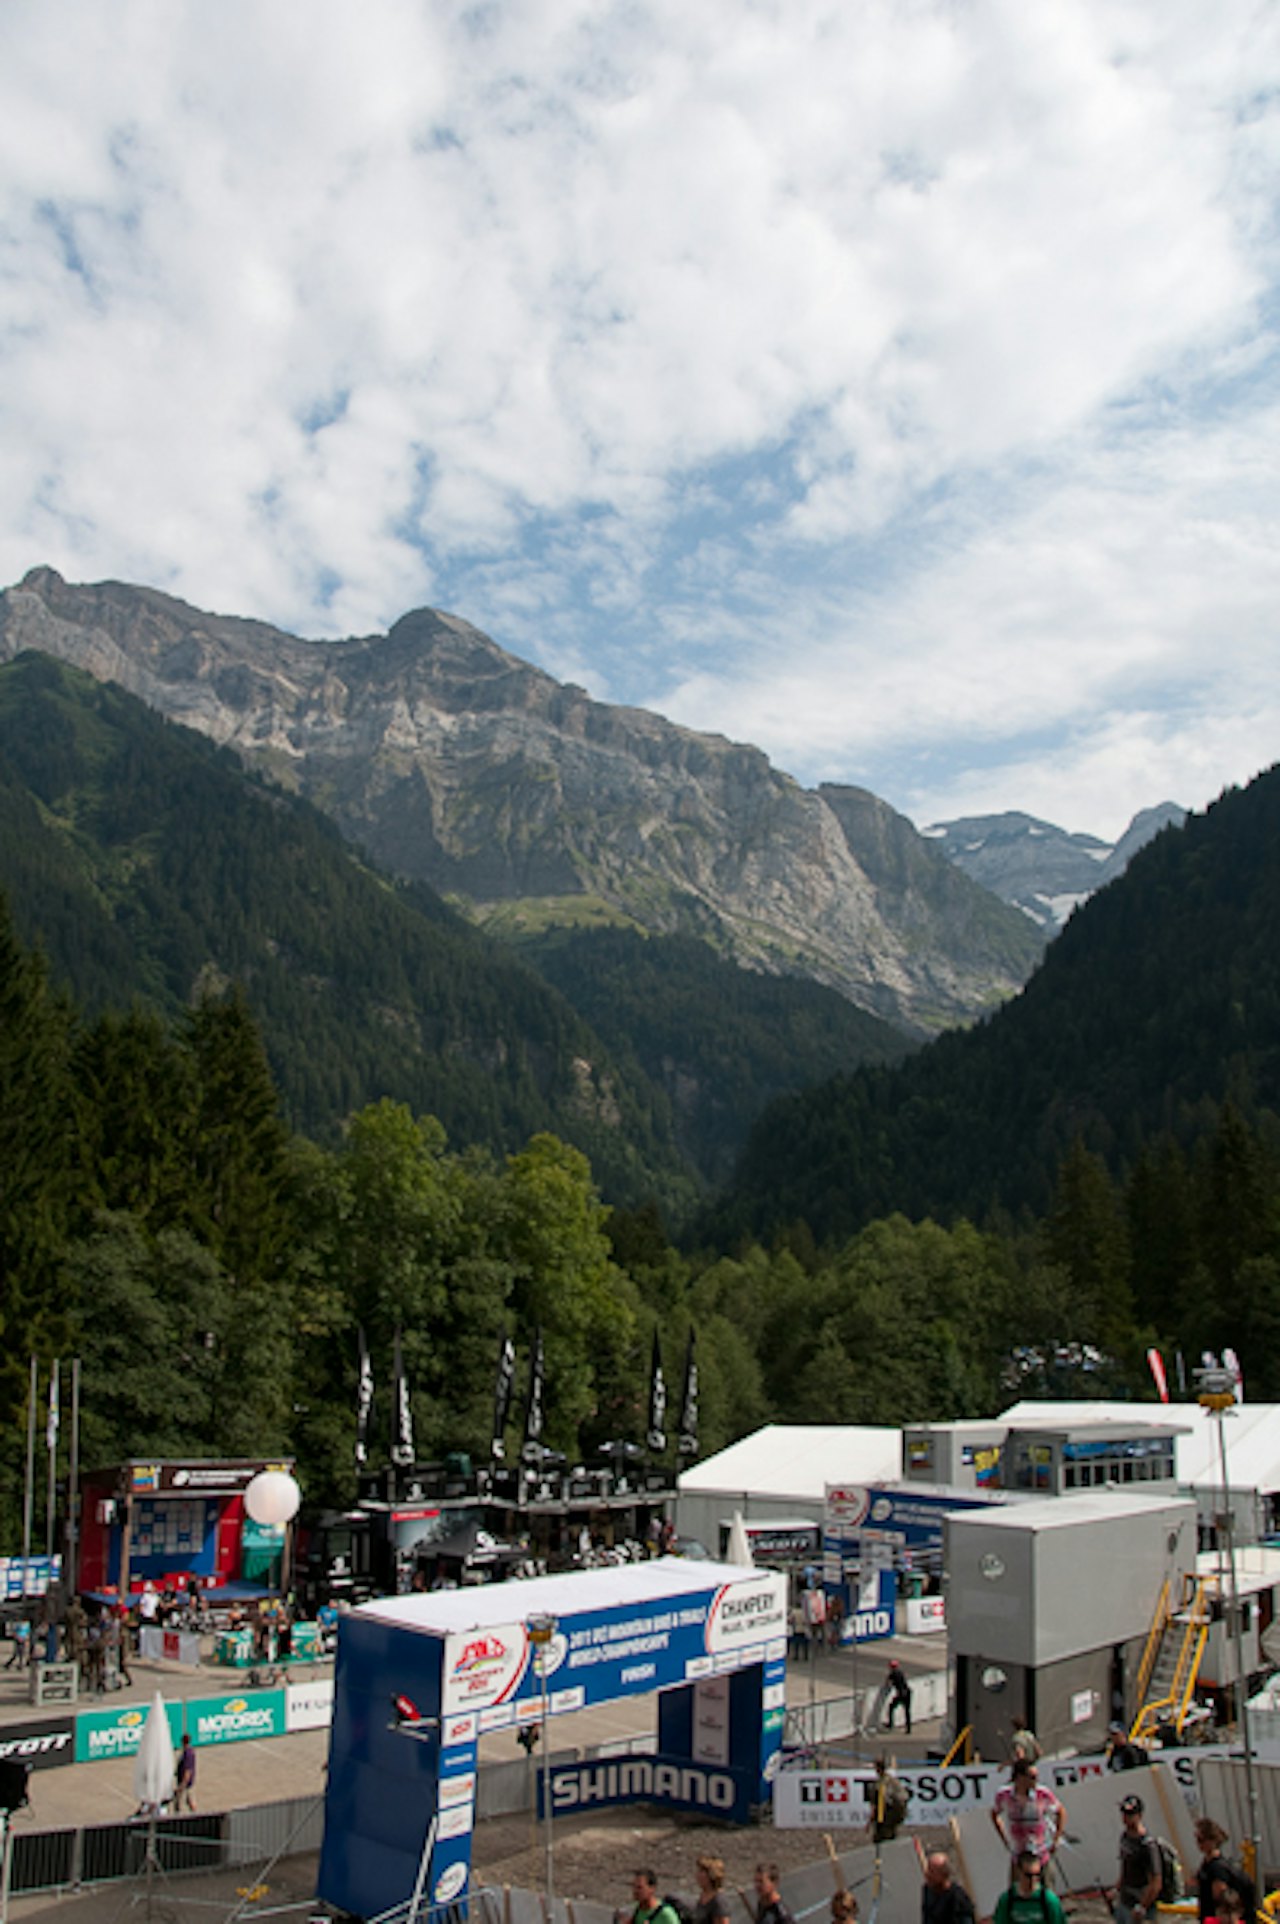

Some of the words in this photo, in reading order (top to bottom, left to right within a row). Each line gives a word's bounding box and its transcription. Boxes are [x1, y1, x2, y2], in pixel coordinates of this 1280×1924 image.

[198, 1709, 274, 1733] MOTOREX
[552, 1761, 736, 1809] SHIMANO
[853, 1773, 988, 1802] TSSOT
